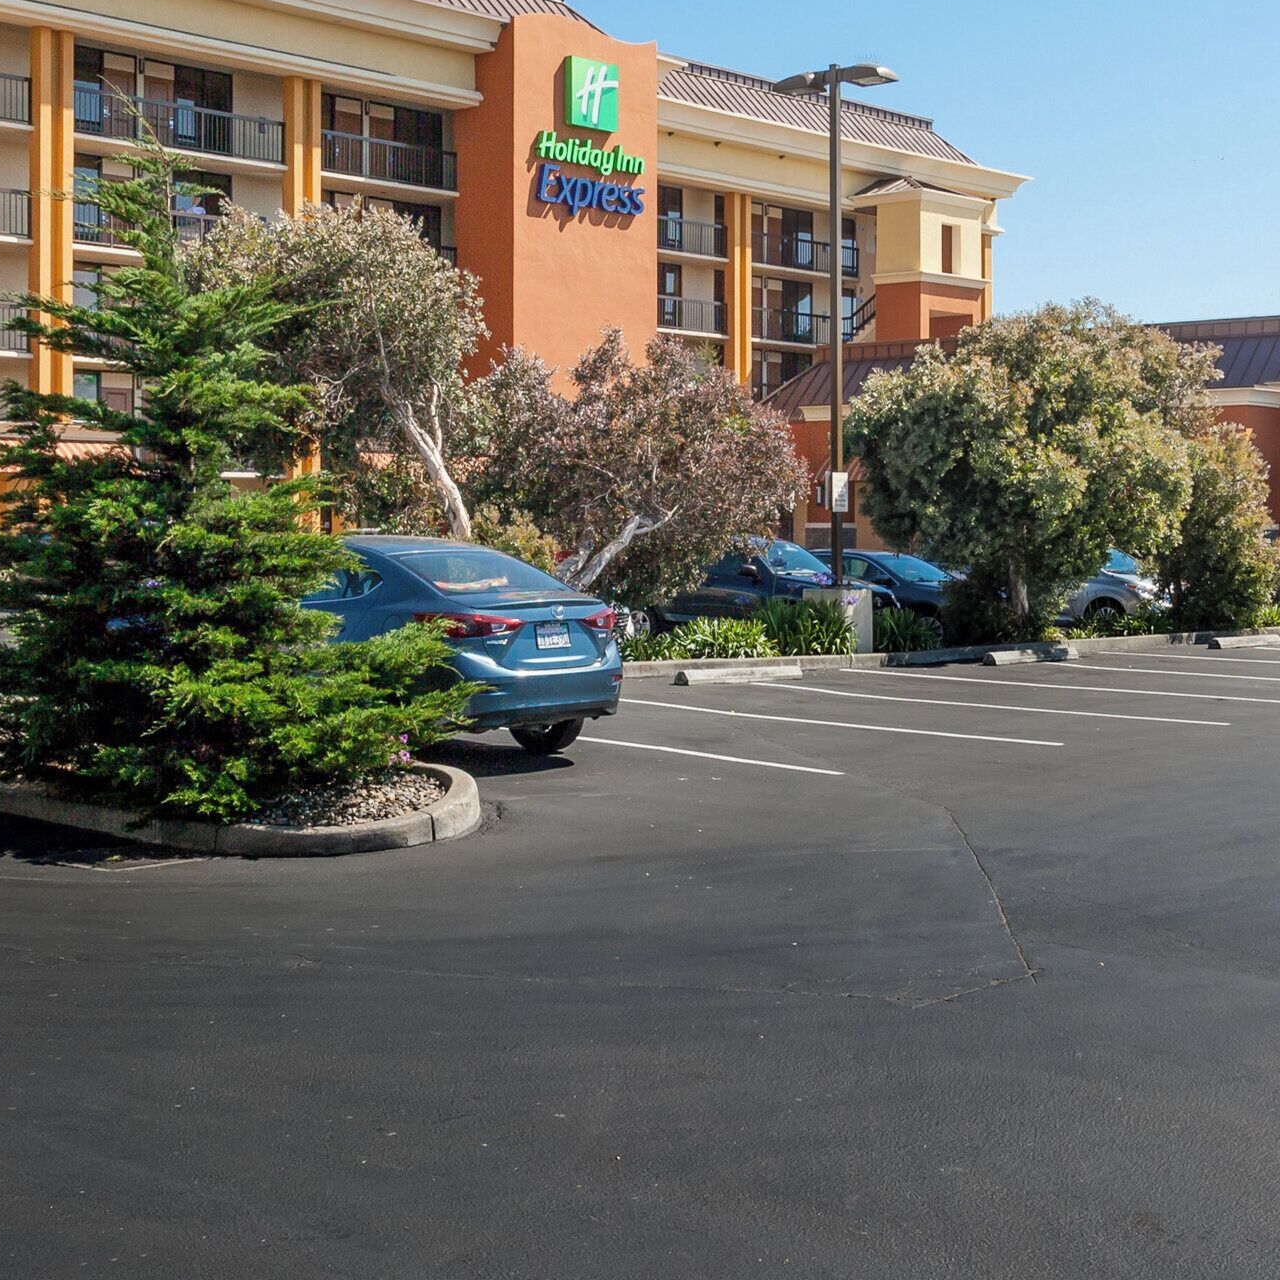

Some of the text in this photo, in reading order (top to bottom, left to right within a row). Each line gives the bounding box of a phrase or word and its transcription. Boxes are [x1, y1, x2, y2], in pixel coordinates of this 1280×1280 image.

[538, 130, 646, 176] Holiday Inn
[538, 163, 646, 217] Express
